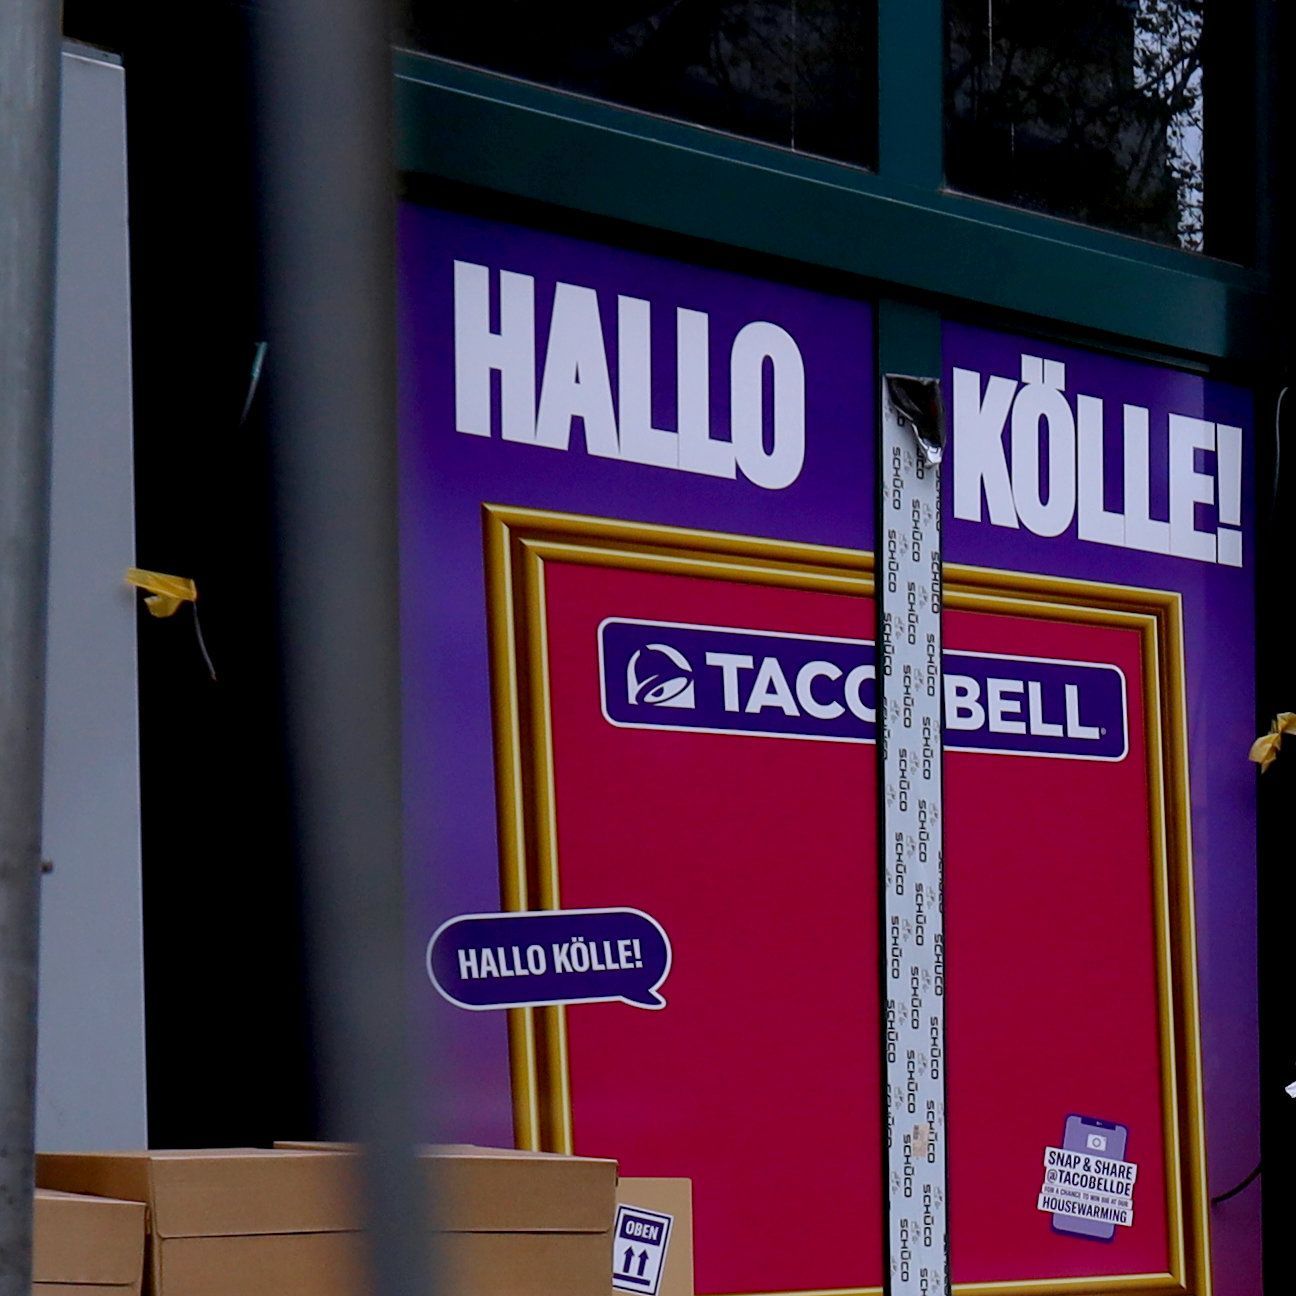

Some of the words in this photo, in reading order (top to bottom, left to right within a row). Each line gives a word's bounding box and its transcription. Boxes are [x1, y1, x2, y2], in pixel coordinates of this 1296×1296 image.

[453, 259, 804, 490] HALLO
[953, 353, 1243, 568] KÖLLE!
[944, 675, 1100, 740] BELL
[457, 939, 547, 981] HALLO
[553, 934, 644, 975] KÖLLE!
[1048, 1151, 1081, 1168] SNAP
[1083, 1157, 1091, 1172] &
[1094, 1160, 1133, 1180] SHARE
[1047, 1169, 1131, 1196] @TACOBELLDE
[1042, 1197, 1127, 1223] HOUSEWARMING
[626, 1220, 659, 1240] OBEN
